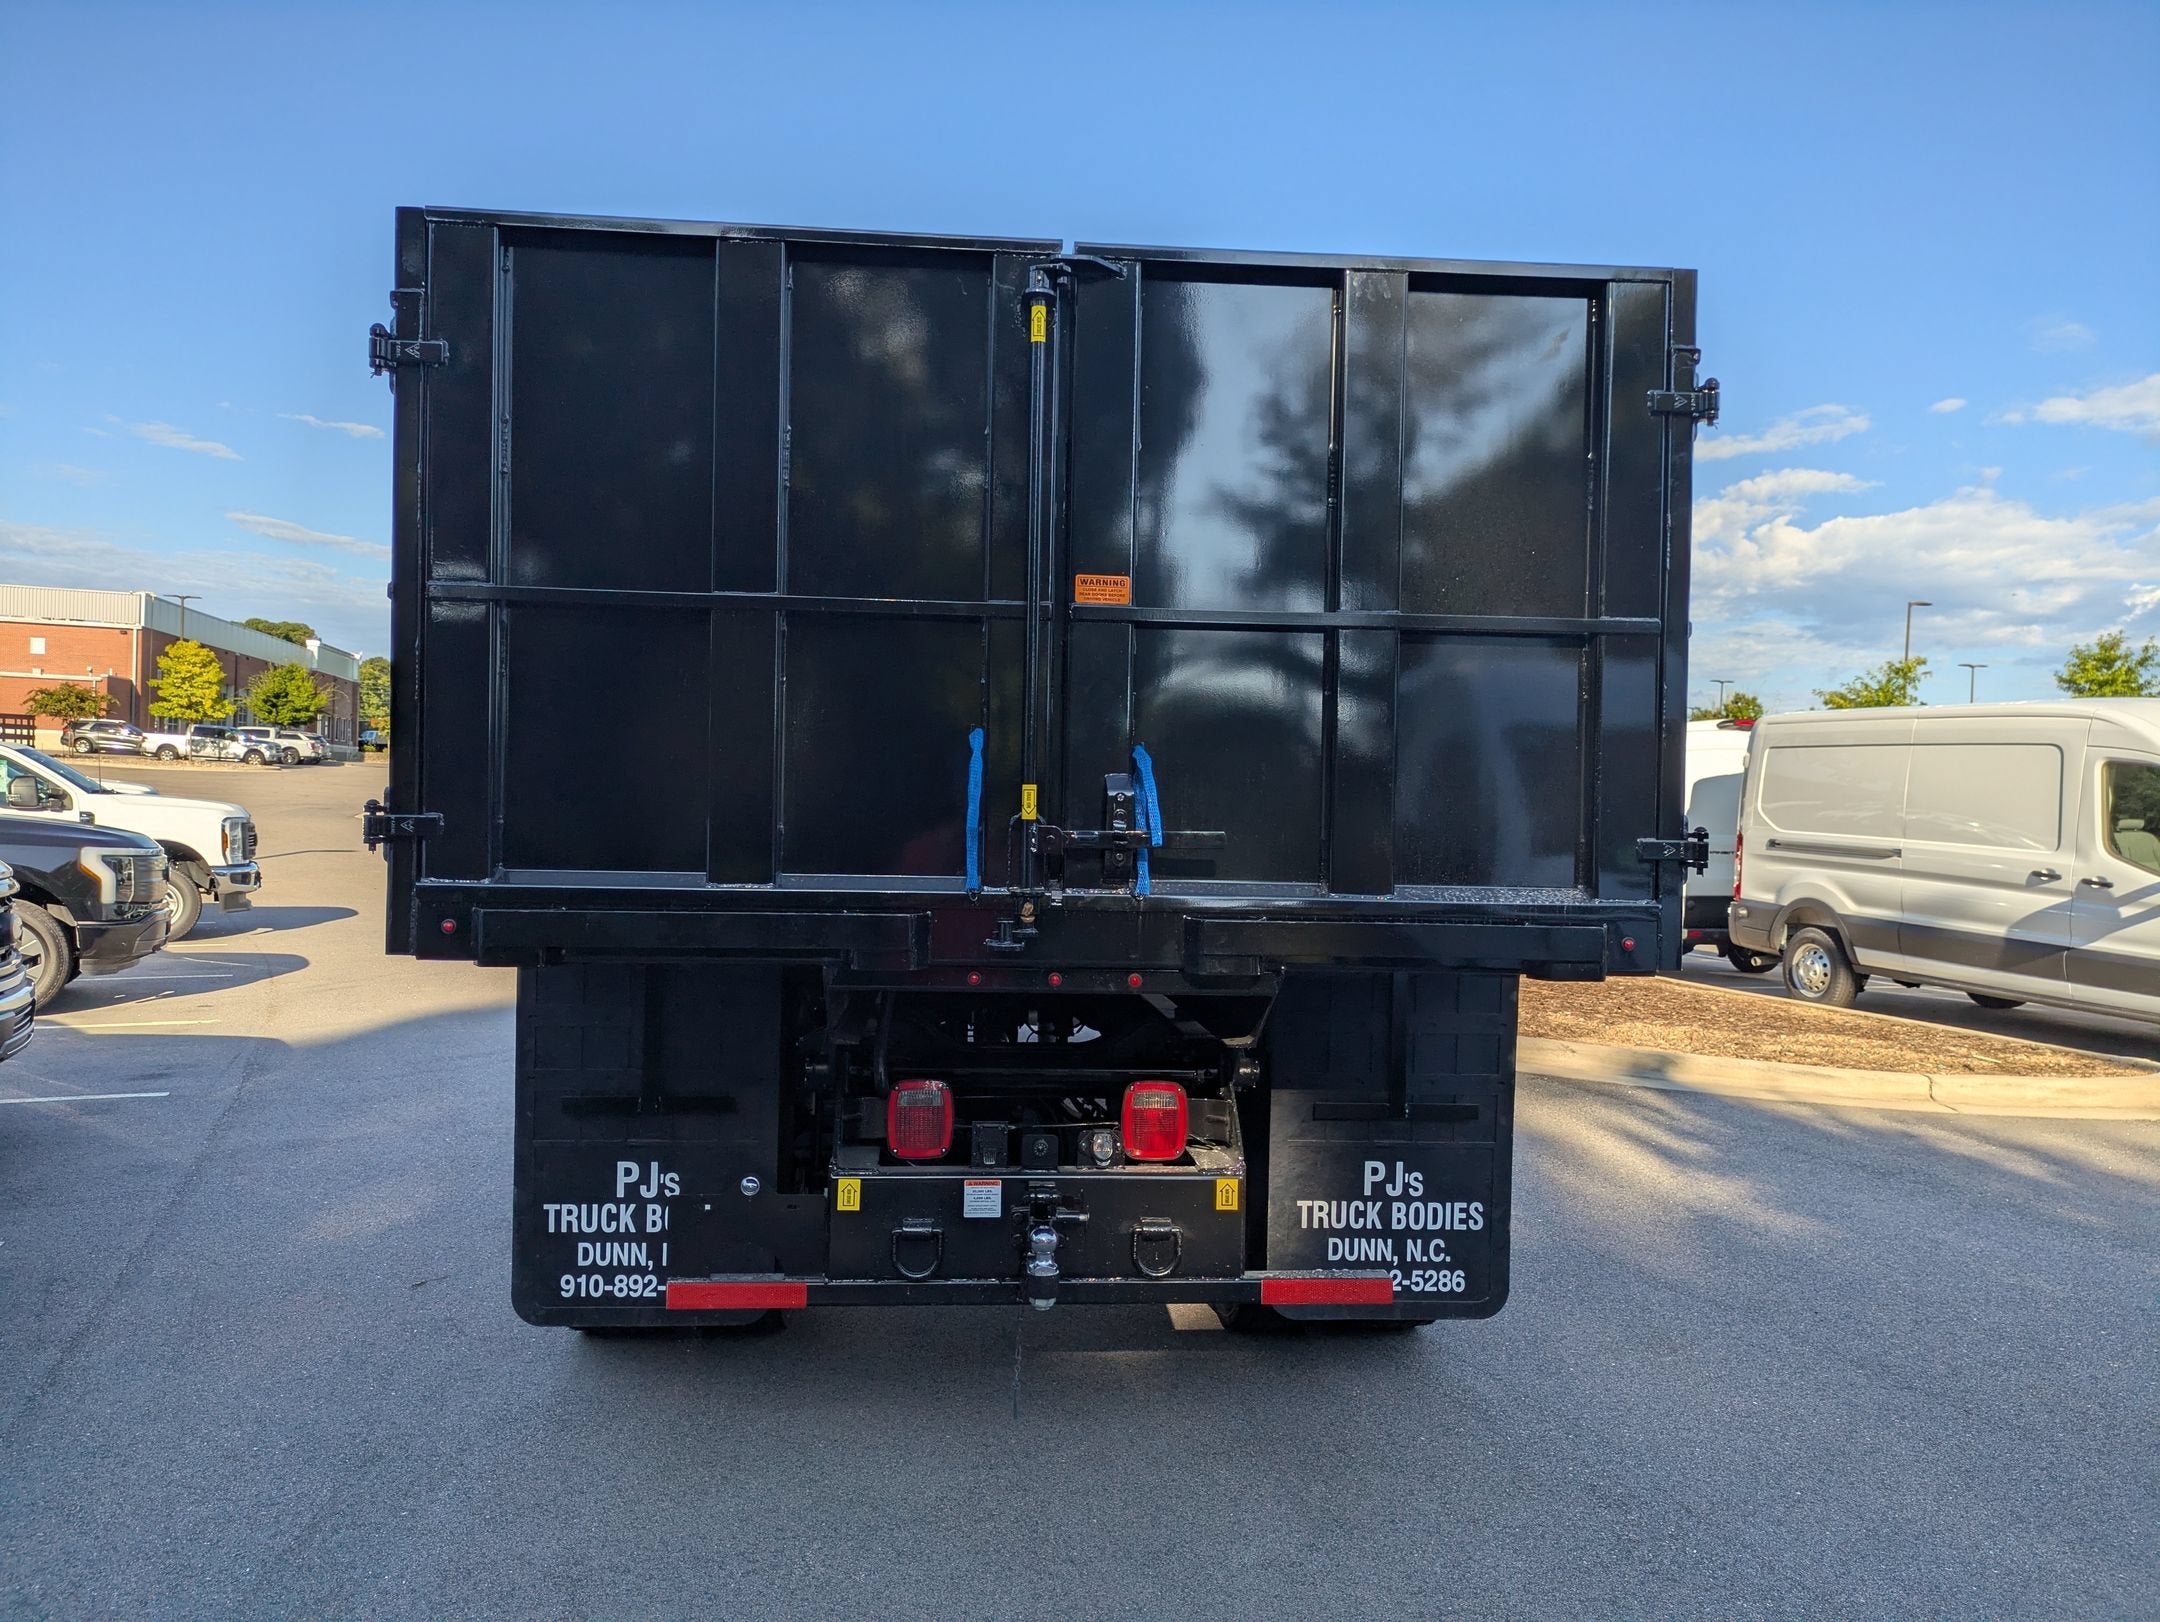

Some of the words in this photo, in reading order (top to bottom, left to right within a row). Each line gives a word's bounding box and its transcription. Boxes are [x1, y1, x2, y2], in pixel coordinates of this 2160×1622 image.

[1079, 578, 1126, 587] WARNING
[617, 1161, 681, 1199] PJ's
[1363, 1160, 1424, 1197] PJ's
[543, 1203, 637, 1233] TRUCK
[1296, 1199, 1383, 1230] TRUCK
[1391, 1201, 1484, 1231] BODIES
[577, 1242, 654, 1272] DUNN,
[1327, 1237, 1399, 1267] DUNN,
[1406, 1238, 1451, 1263] N.C.
